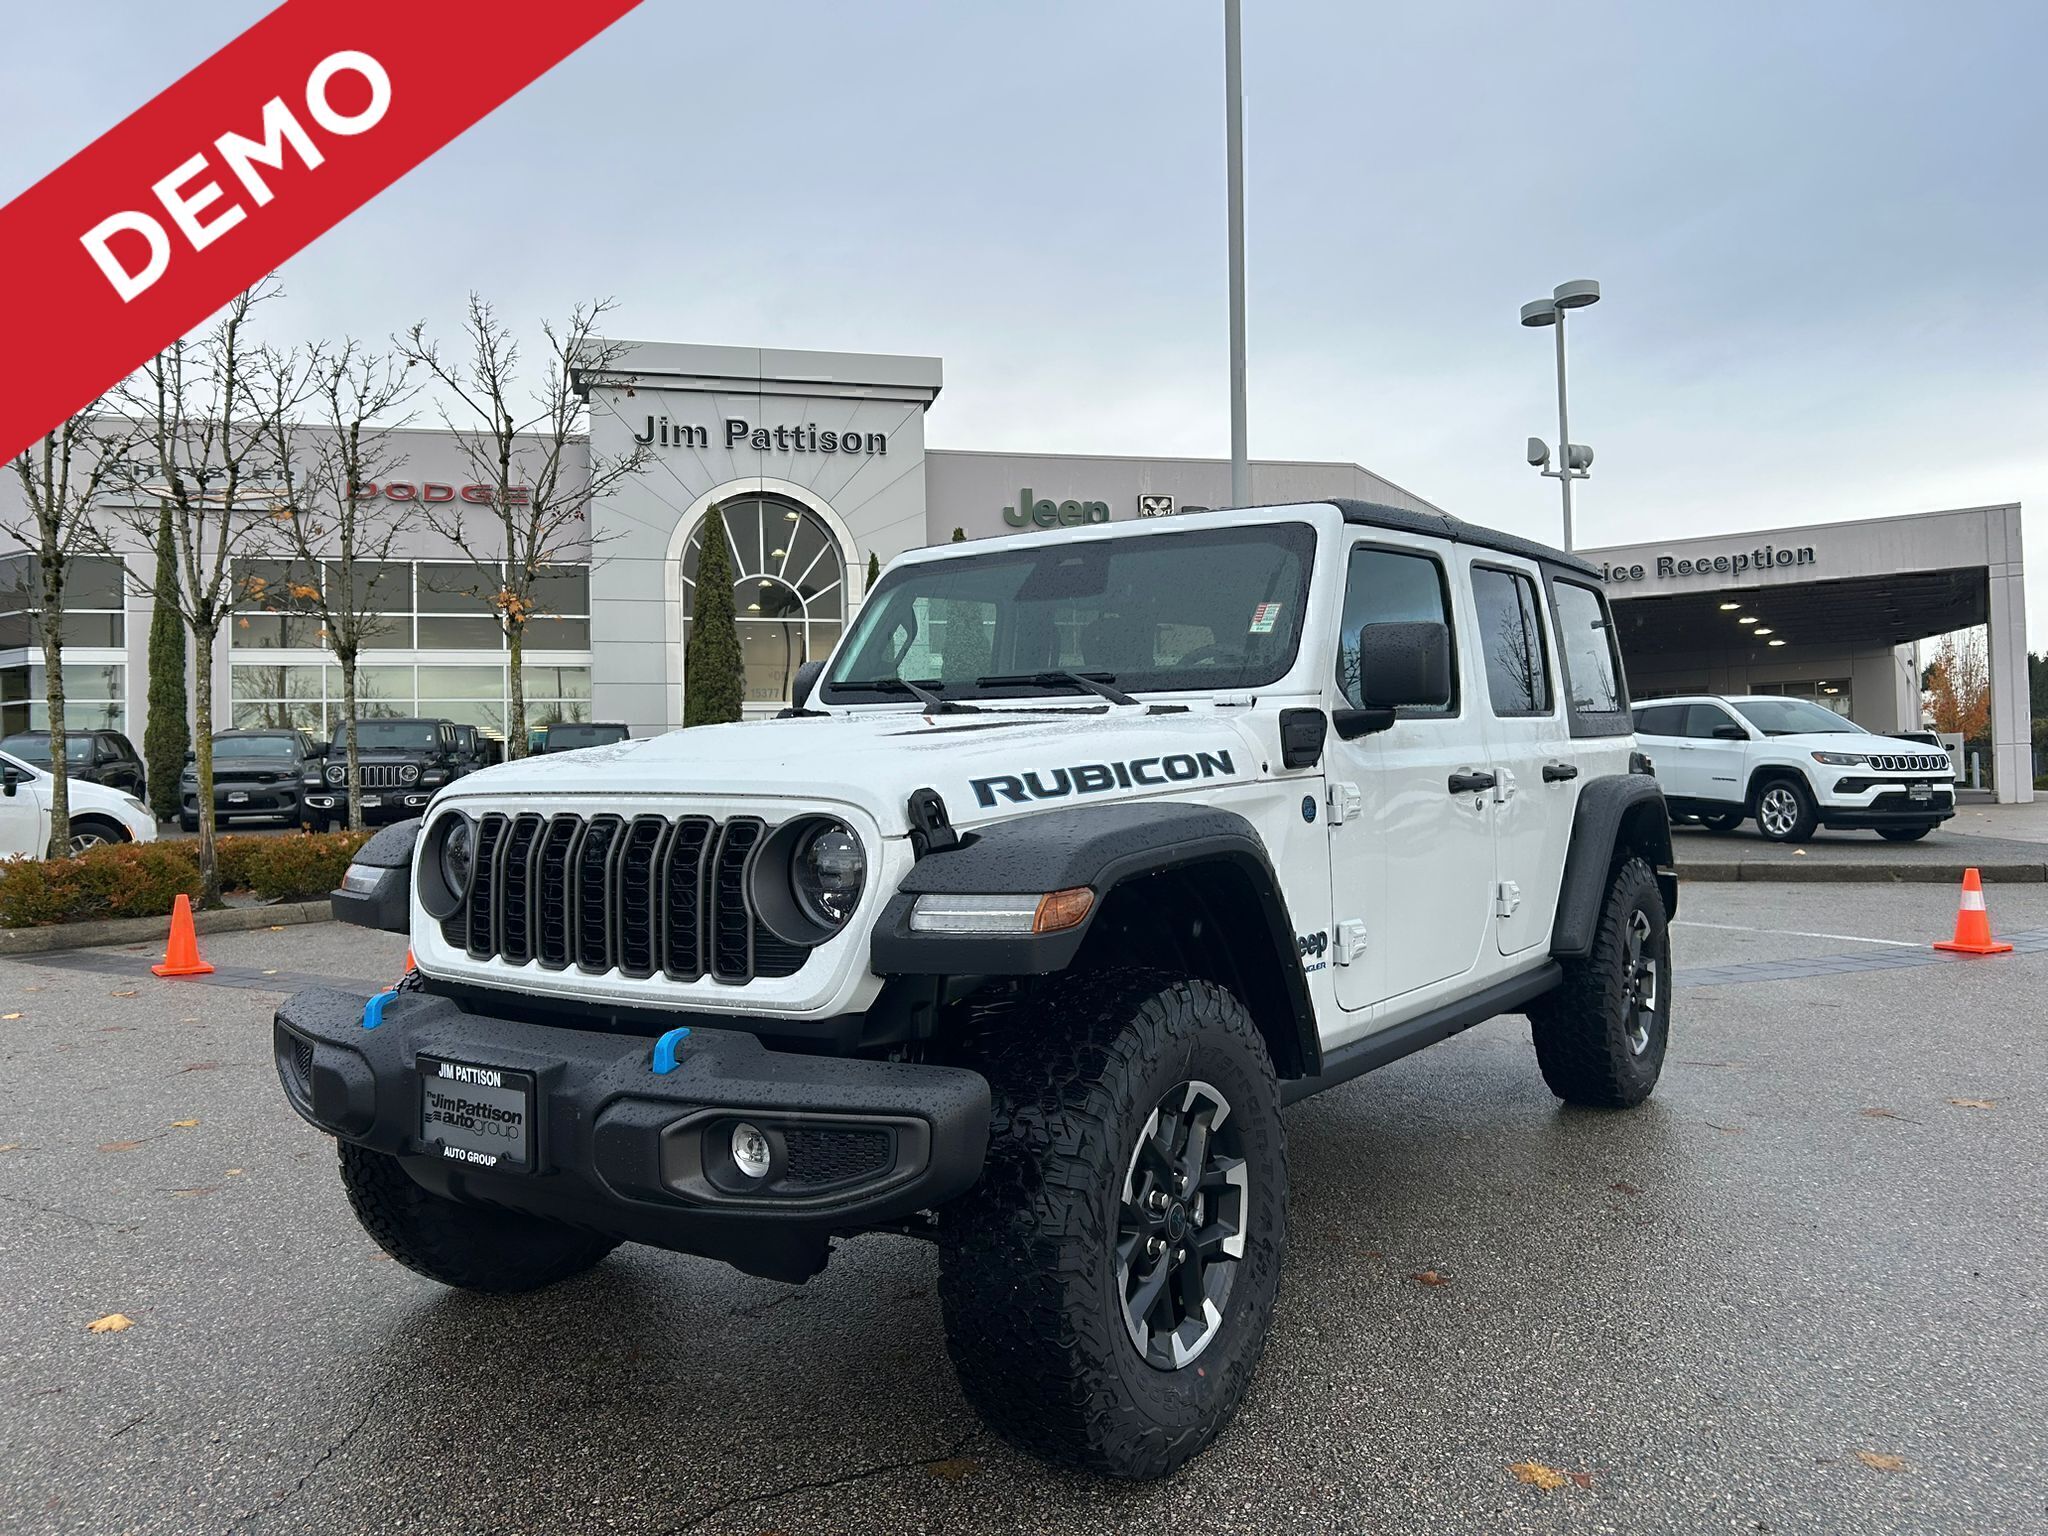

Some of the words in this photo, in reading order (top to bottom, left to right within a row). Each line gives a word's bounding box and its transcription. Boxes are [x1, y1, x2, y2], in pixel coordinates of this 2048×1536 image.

[634, 416, 709, 447] Jim
[725, 419, 889, 455] Pattison
[346, 481, 530, 505] DODGE
[1656, 545, 1816, 577] Reception
[968, 749, 1236, 808] RUBICON
[1297, 931, 1328, 958] eep
[438, 1062, 454, 1080] JIM
[455, 1066, 501, 1088] PATTISON
[443, 1146, 466, 1161] AUTO
[467, 1151, 497, 1167] GROUP
